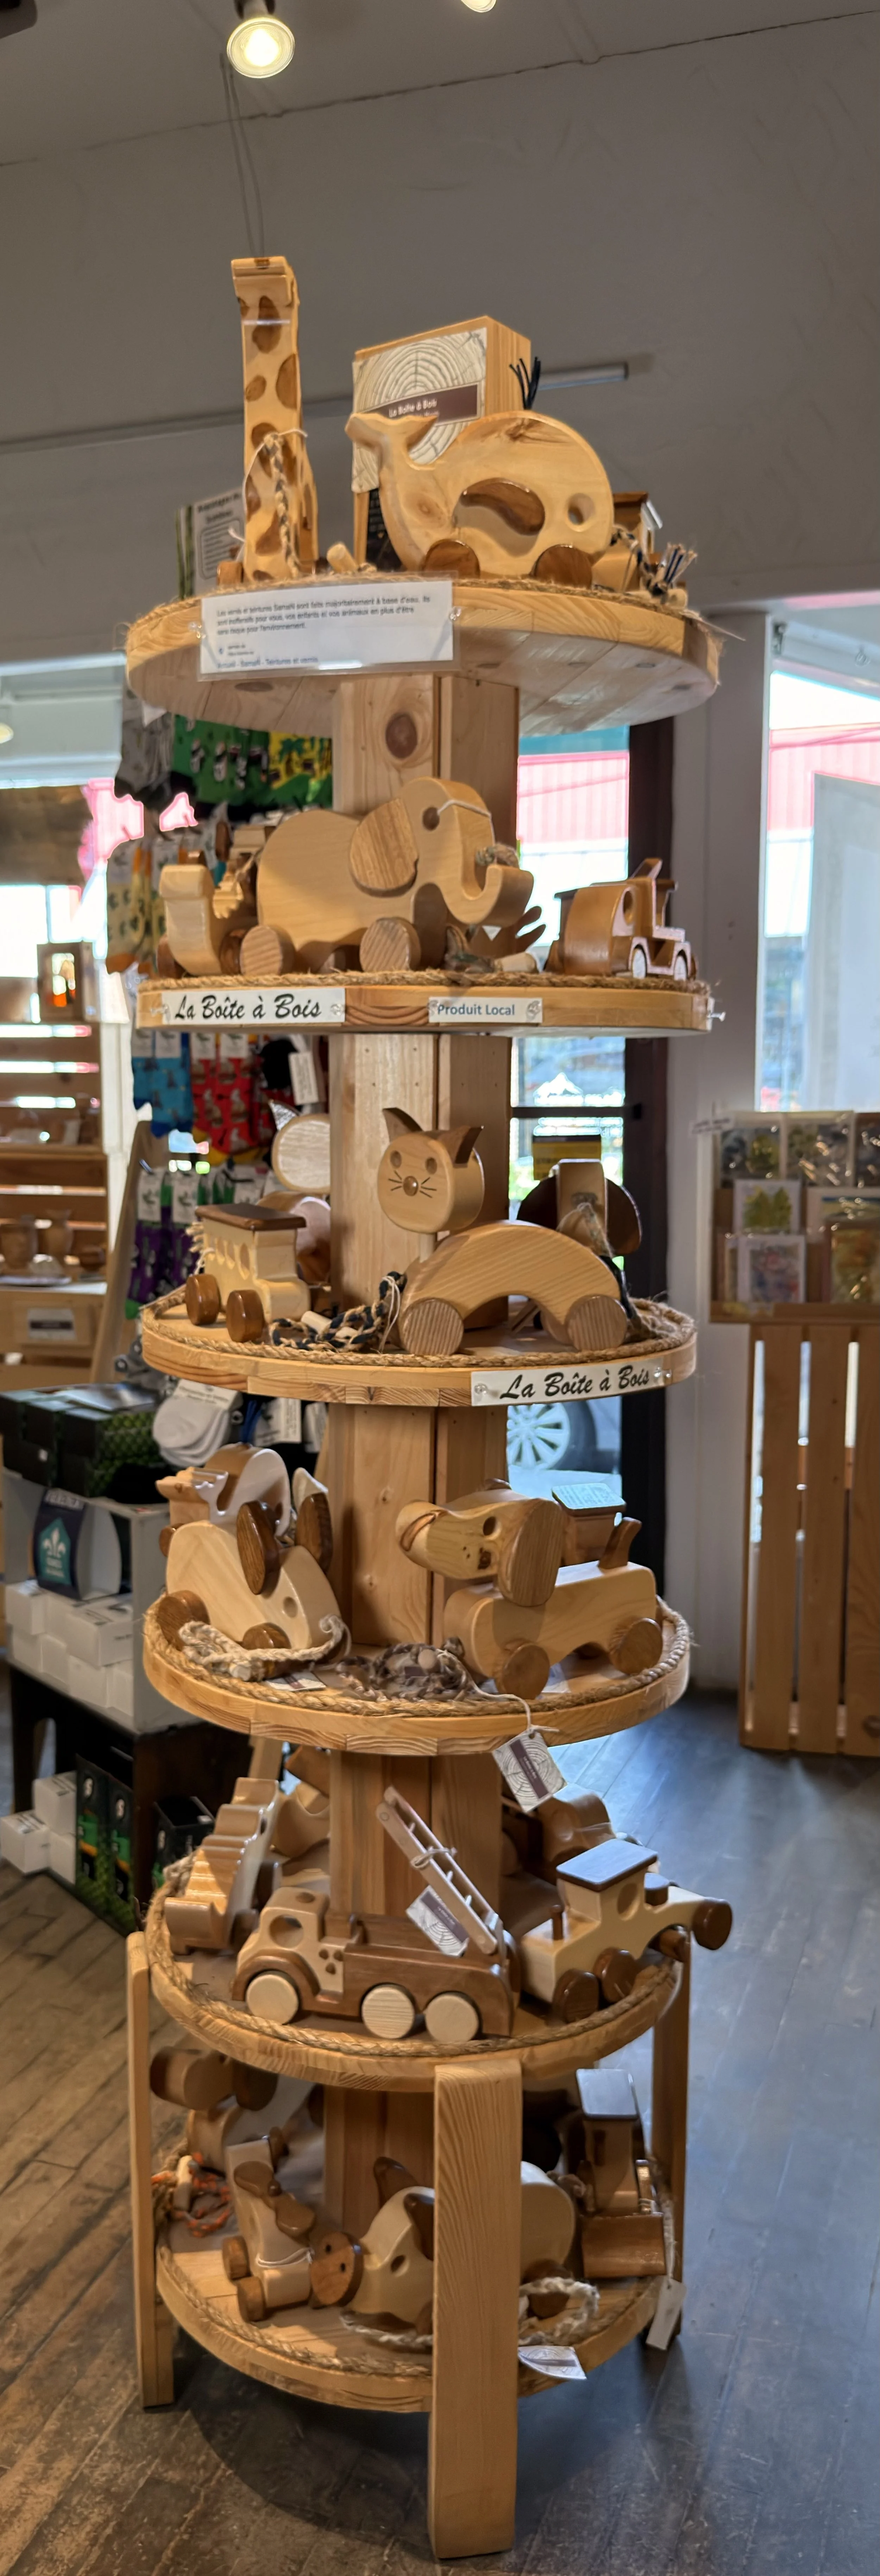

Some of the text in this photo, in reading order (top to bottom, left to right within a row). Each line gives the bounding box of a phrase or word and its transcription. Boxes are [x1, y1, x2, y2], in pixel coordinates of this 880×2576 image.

[175, 993, 322, 1019] La Boîte à Bois
[438, 1004, 515, 1016] Produit Local
[499, 1364, 650, 1400] La Boîte à Bois
